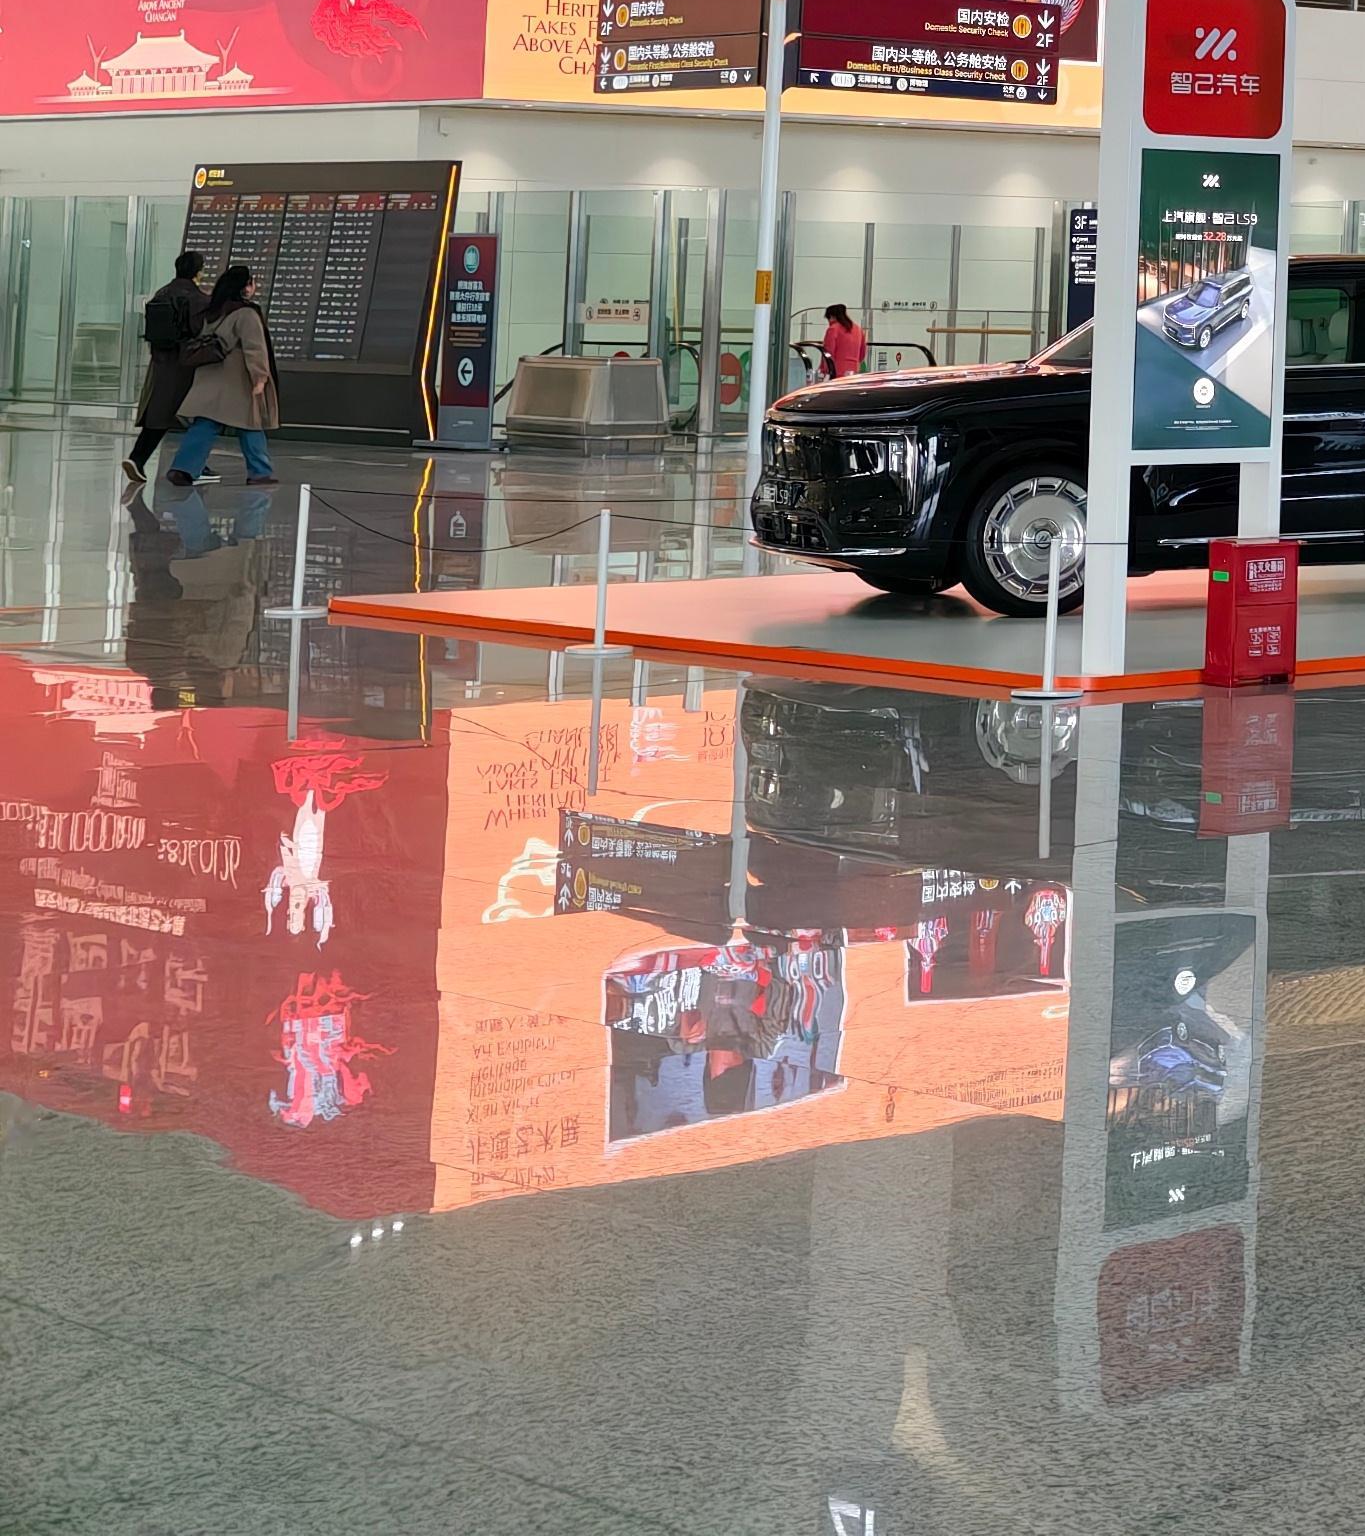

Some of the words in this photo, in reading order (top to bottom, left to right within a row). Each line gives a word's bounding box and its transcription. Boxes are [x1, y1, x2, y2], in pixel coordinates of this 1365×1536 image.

[630, 0, 665, 18] 国内安检
[521, 14, 576, 36] TAKES
[669, 15, 684, 25] Check
[957, 8, 1010, 28] 国内安检
[600, 21, 613, 36] 2F
[924, 22, 957, 33] Domestic
[958, 25, 986, 37] Security
[987, 27, 1009, 38] Check
[513, 33, 575, 54] ABOVE
[1036, 33, 1054, 48] 2F
[872, 46, 1007, 71] 国内头等舱、公务舱安检
[600, 63, 609, 75] 2F
[847, 60, 881, 72] Domestic
[882, 63, 933, 76] First/Business
[933, 66, 953, 77] Class
[954, 67, 983, 80] Security
[984, 70, 1007, 81] Check
[1036, 75, 1049, 86] 2F
[1170, 71, 1261, 96] 智己汽车
[1074, 215, 1088, 230] 3F
